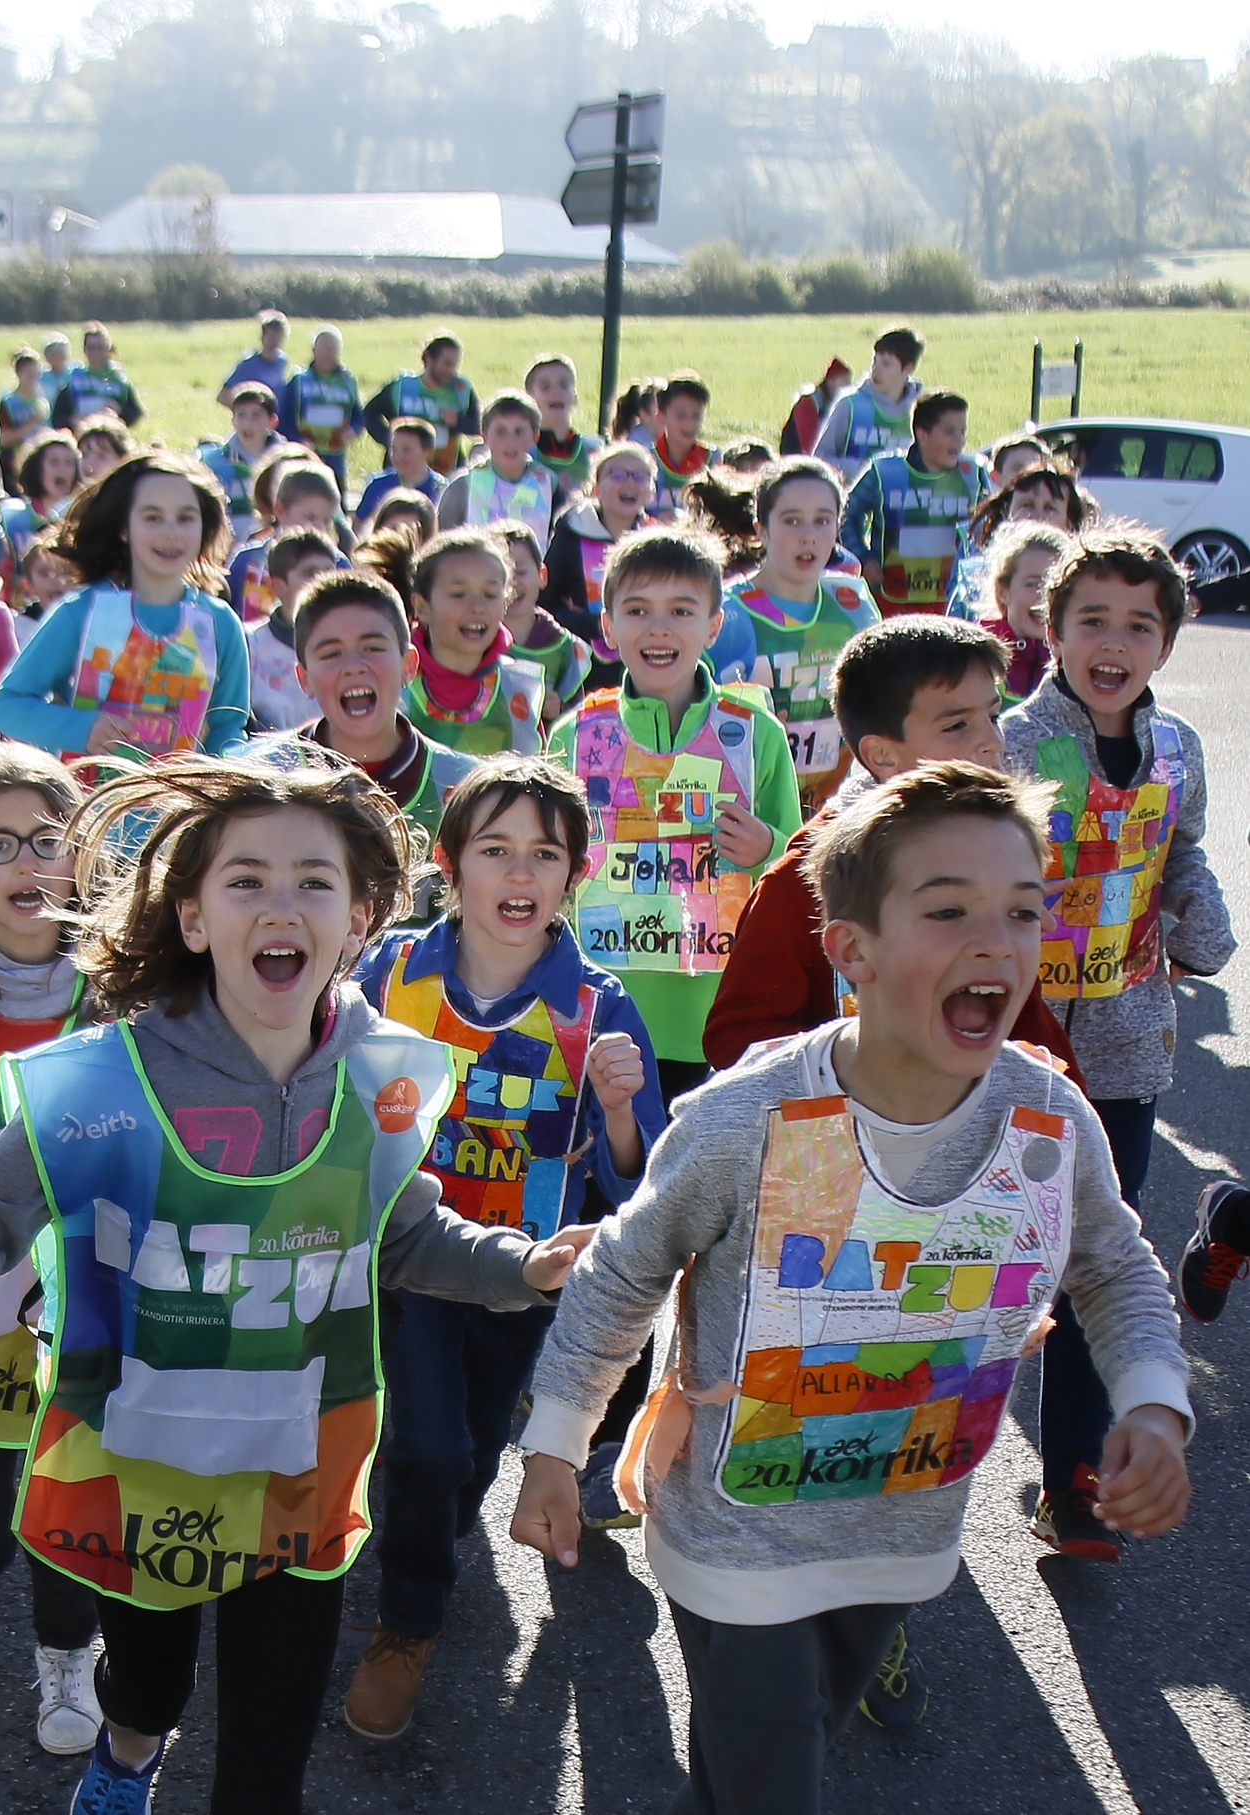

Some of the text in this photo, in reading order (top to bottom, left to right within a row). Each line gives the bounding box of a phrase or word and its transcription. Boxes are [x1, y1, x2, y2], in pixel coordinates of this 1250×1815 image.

[635, 910, 665, 930] aek
[1090, 940, 1119, 961] aek
[86, 1110, 137, 1140] eitb
[778, 1233, 1043, 1313] BATZUK
[824, 1430, 878, 1458] aek
[152, 1503, 225, 1547] aek
